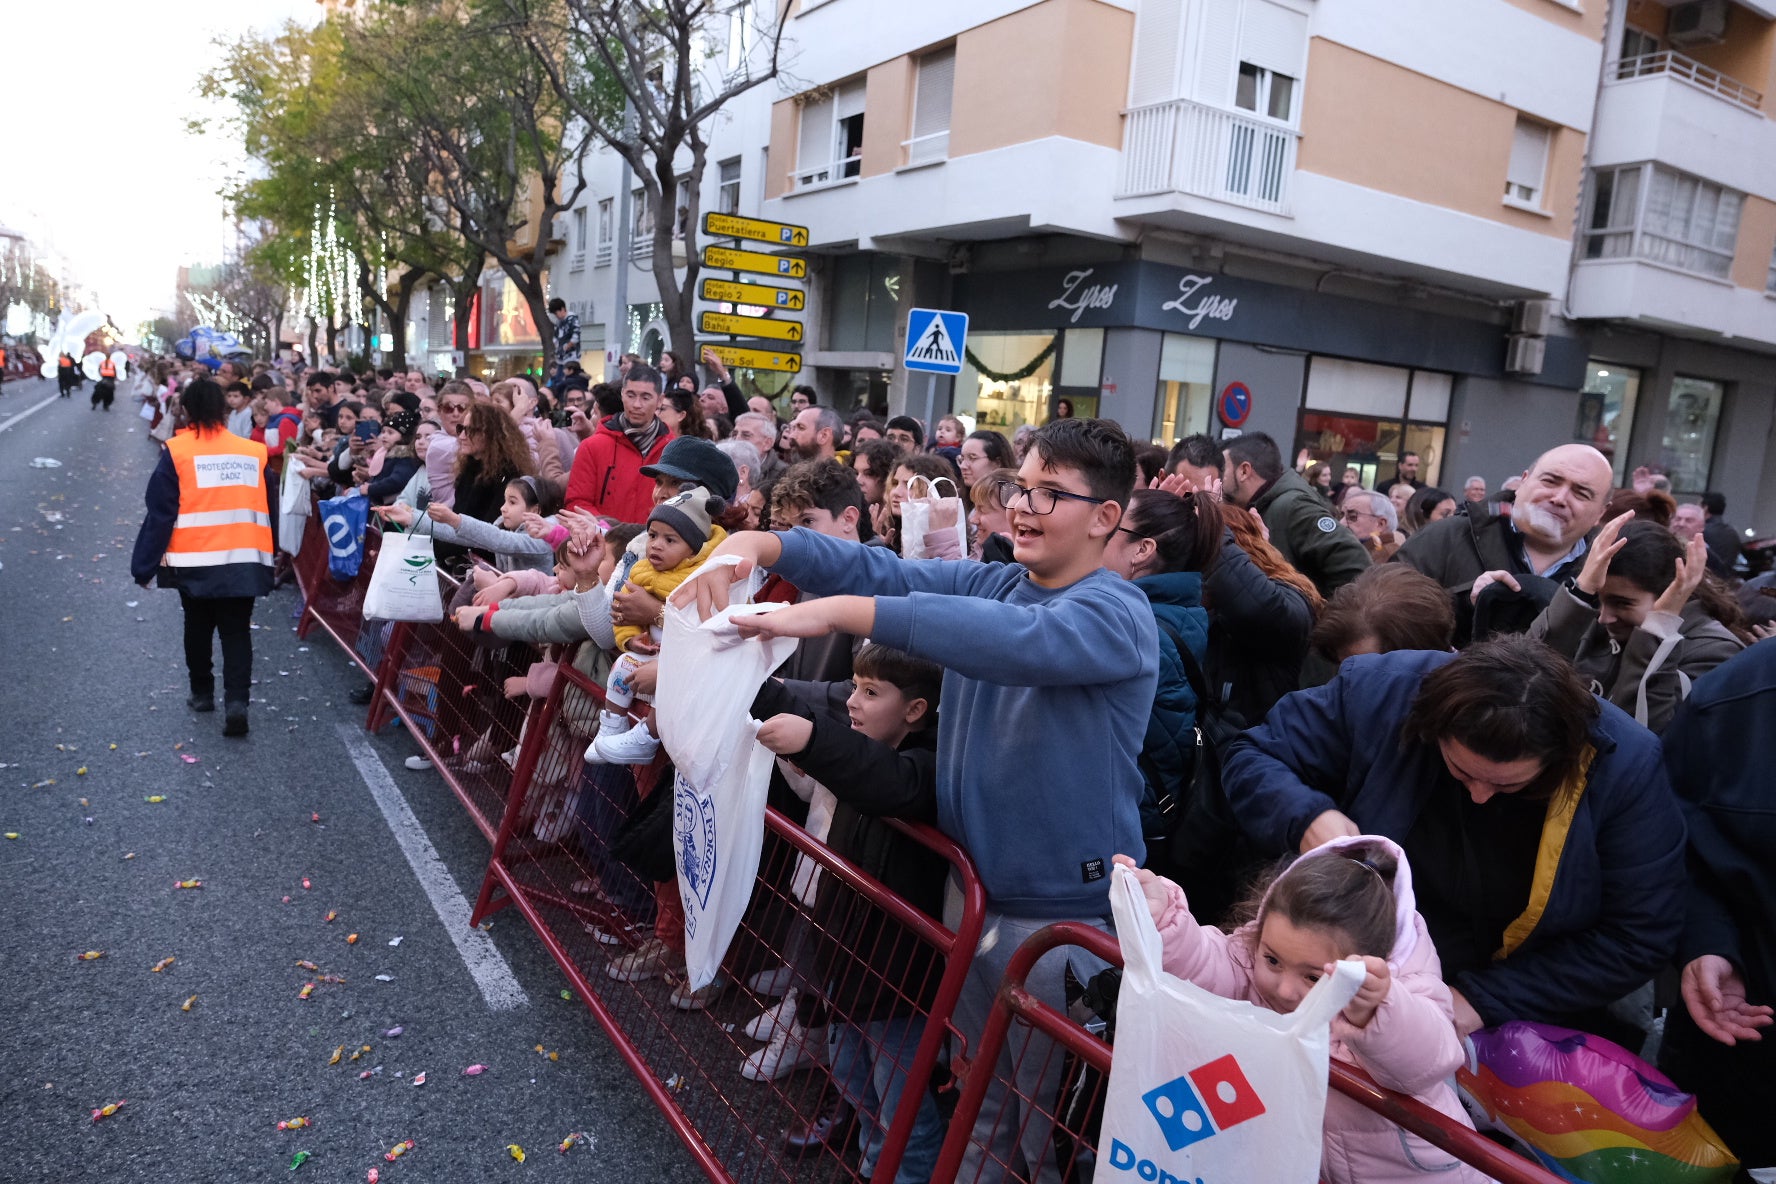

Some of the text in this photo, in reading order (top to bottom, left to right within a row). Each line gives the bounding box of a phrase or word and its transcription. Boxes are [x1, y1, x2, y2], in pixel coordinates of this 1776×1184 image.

[708, 220, 766, 238] Puertatierra
[707, 254, 734, 267] Regio
[706, 287, 733, 299] Regio
[736, 291, 743, 300] 2
[1048, 268, 1118, 323] Zyros
[1162, 274, 1238, 330] Zyros
[738, 357, 754, 366] Sol
[197, 461, 258, 472] PROTECCIÓN CIVIL
[701, 817, 714, 888] PORRES
